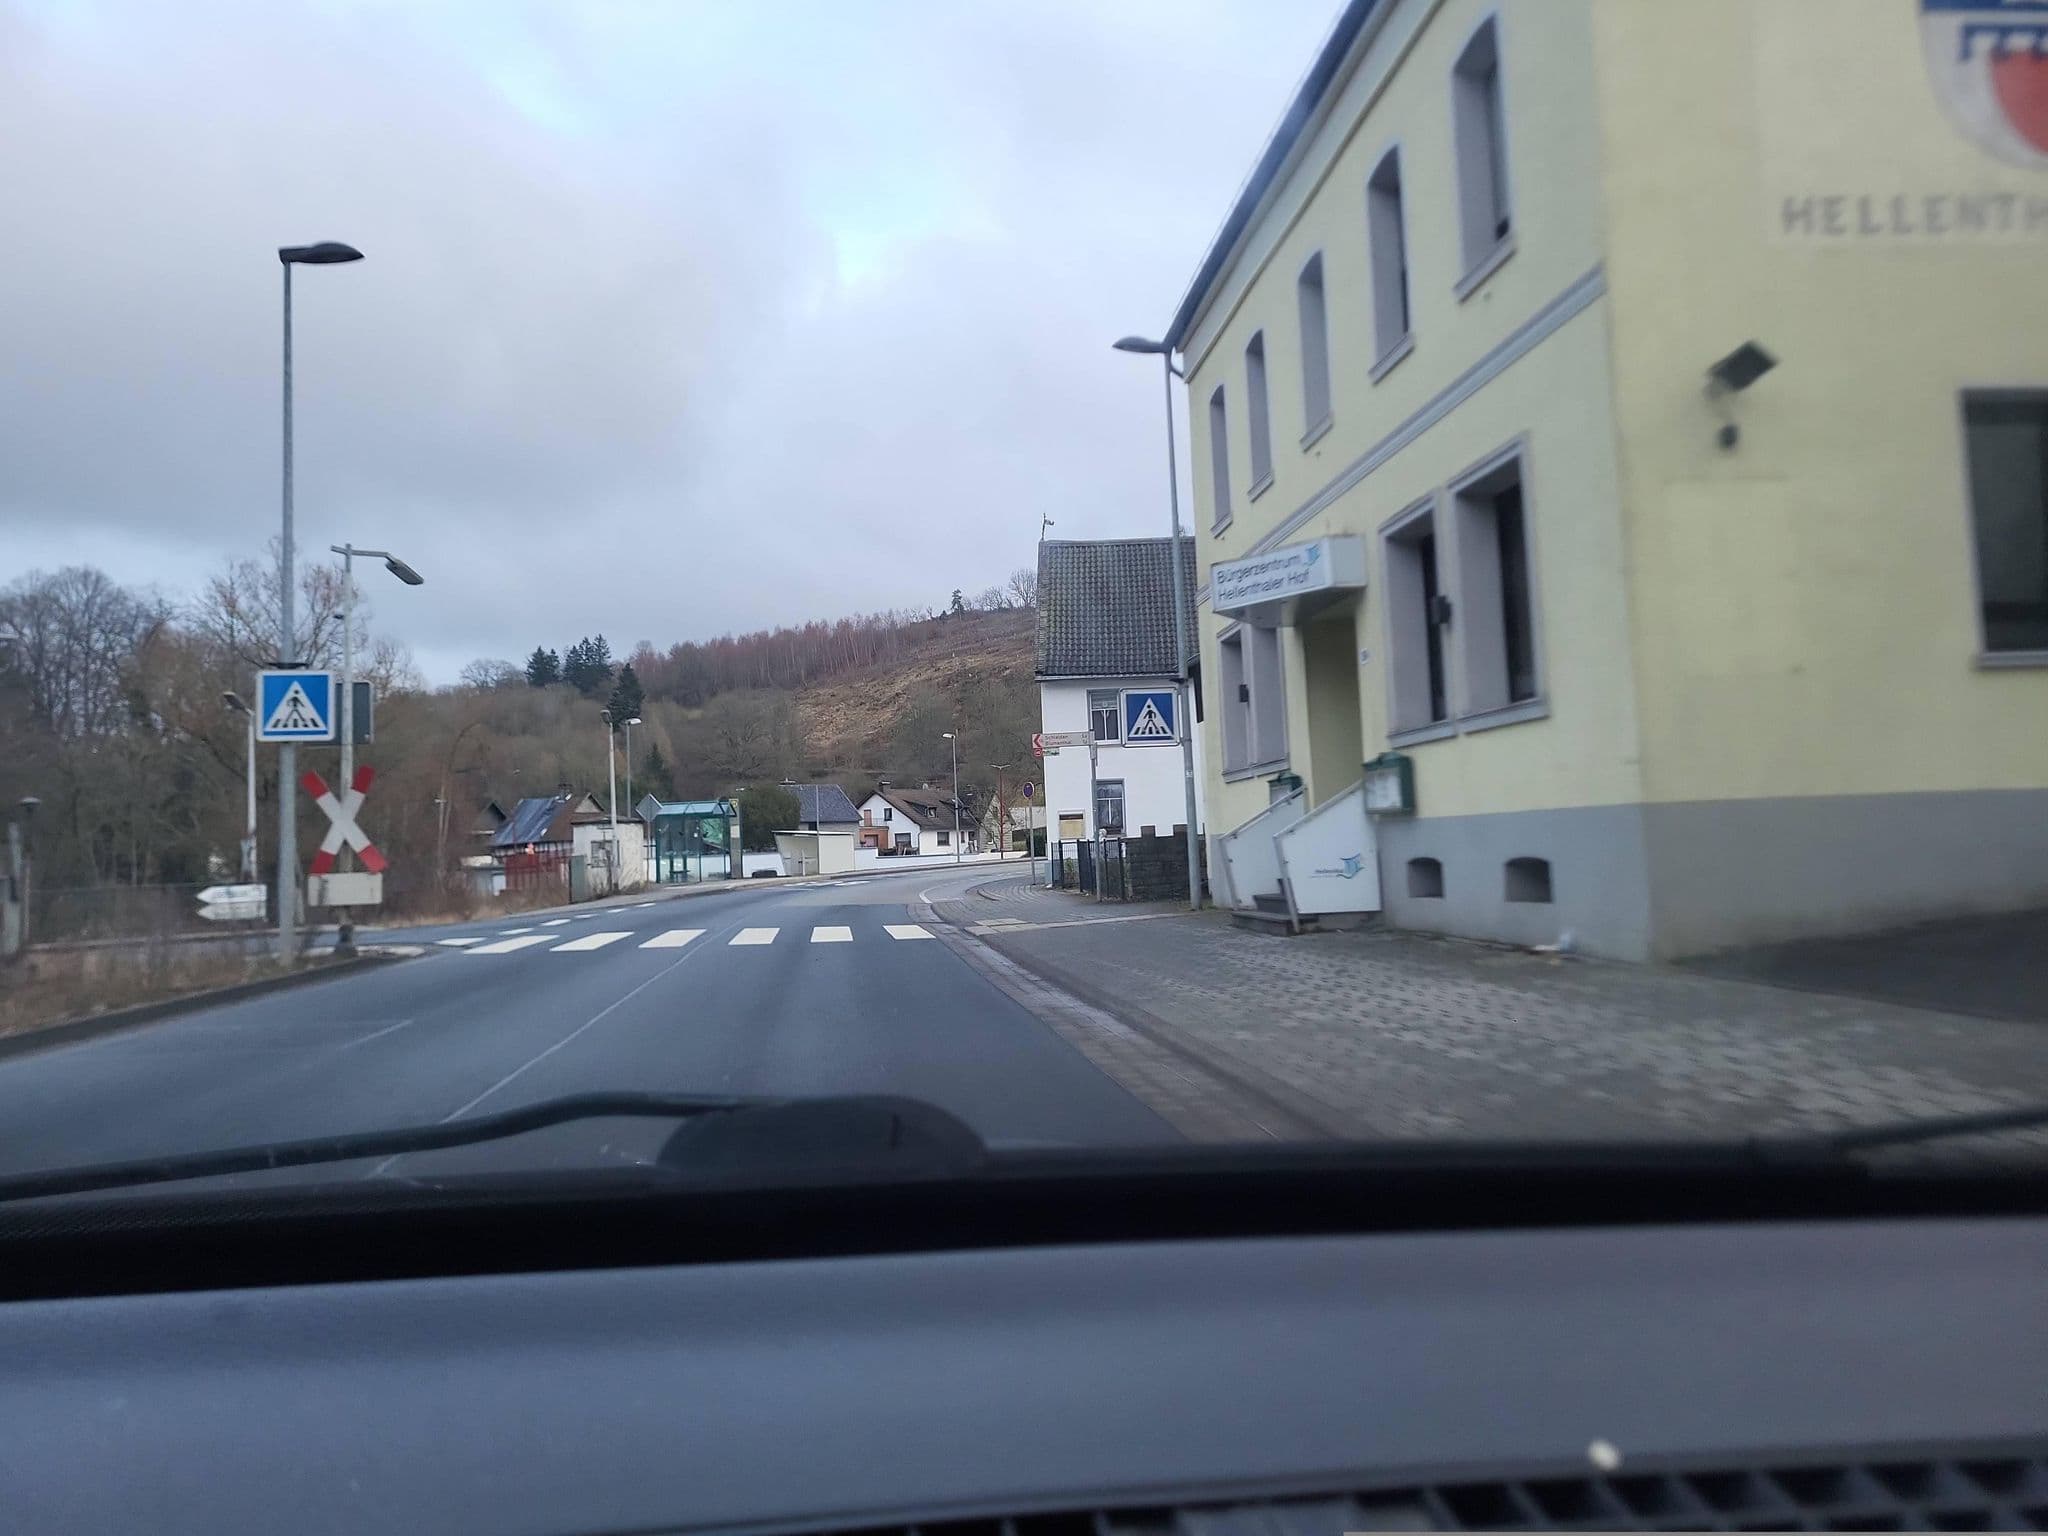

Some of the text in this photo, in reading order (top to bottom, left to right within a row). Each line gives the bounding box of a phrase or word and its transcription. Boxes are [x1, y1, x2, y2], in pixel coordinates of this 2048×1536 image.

[1216, 554, 1301, 584] Bürgerzentrum
[1218, 568, 1310, 600] Hellenthaler Hof
